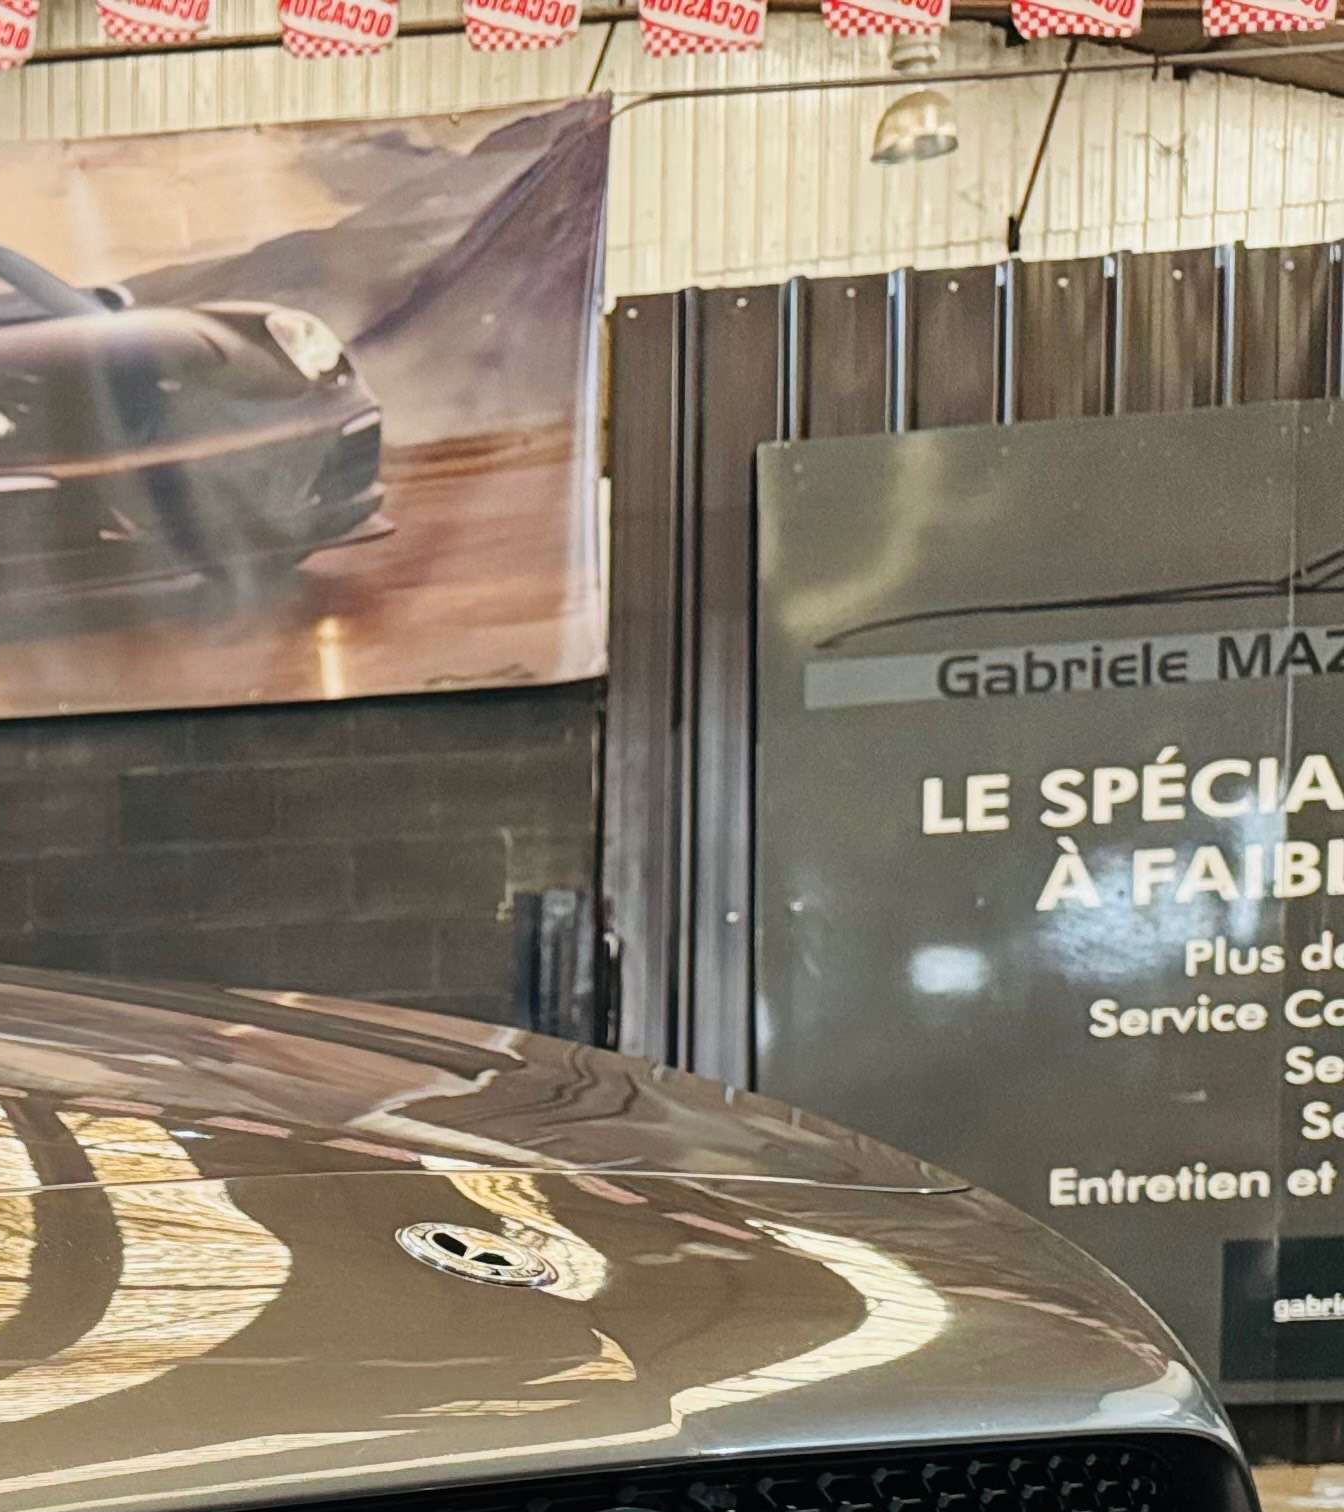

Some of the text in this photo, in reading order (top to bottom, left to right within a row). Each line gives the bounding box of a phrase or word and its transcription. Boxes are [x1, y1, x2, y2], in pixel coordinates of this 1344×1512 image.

[936, 642, 1188, 698] Gabriele
[922, 745, 1344, 834] LE SPÉCIA
[1035, 836, 1103, 911] À
[1185, 935, 1286, 977] Plus
[1089, 994, 1269, 1038] Service
[1049, 1161, 1339, 1207] Entretien et
